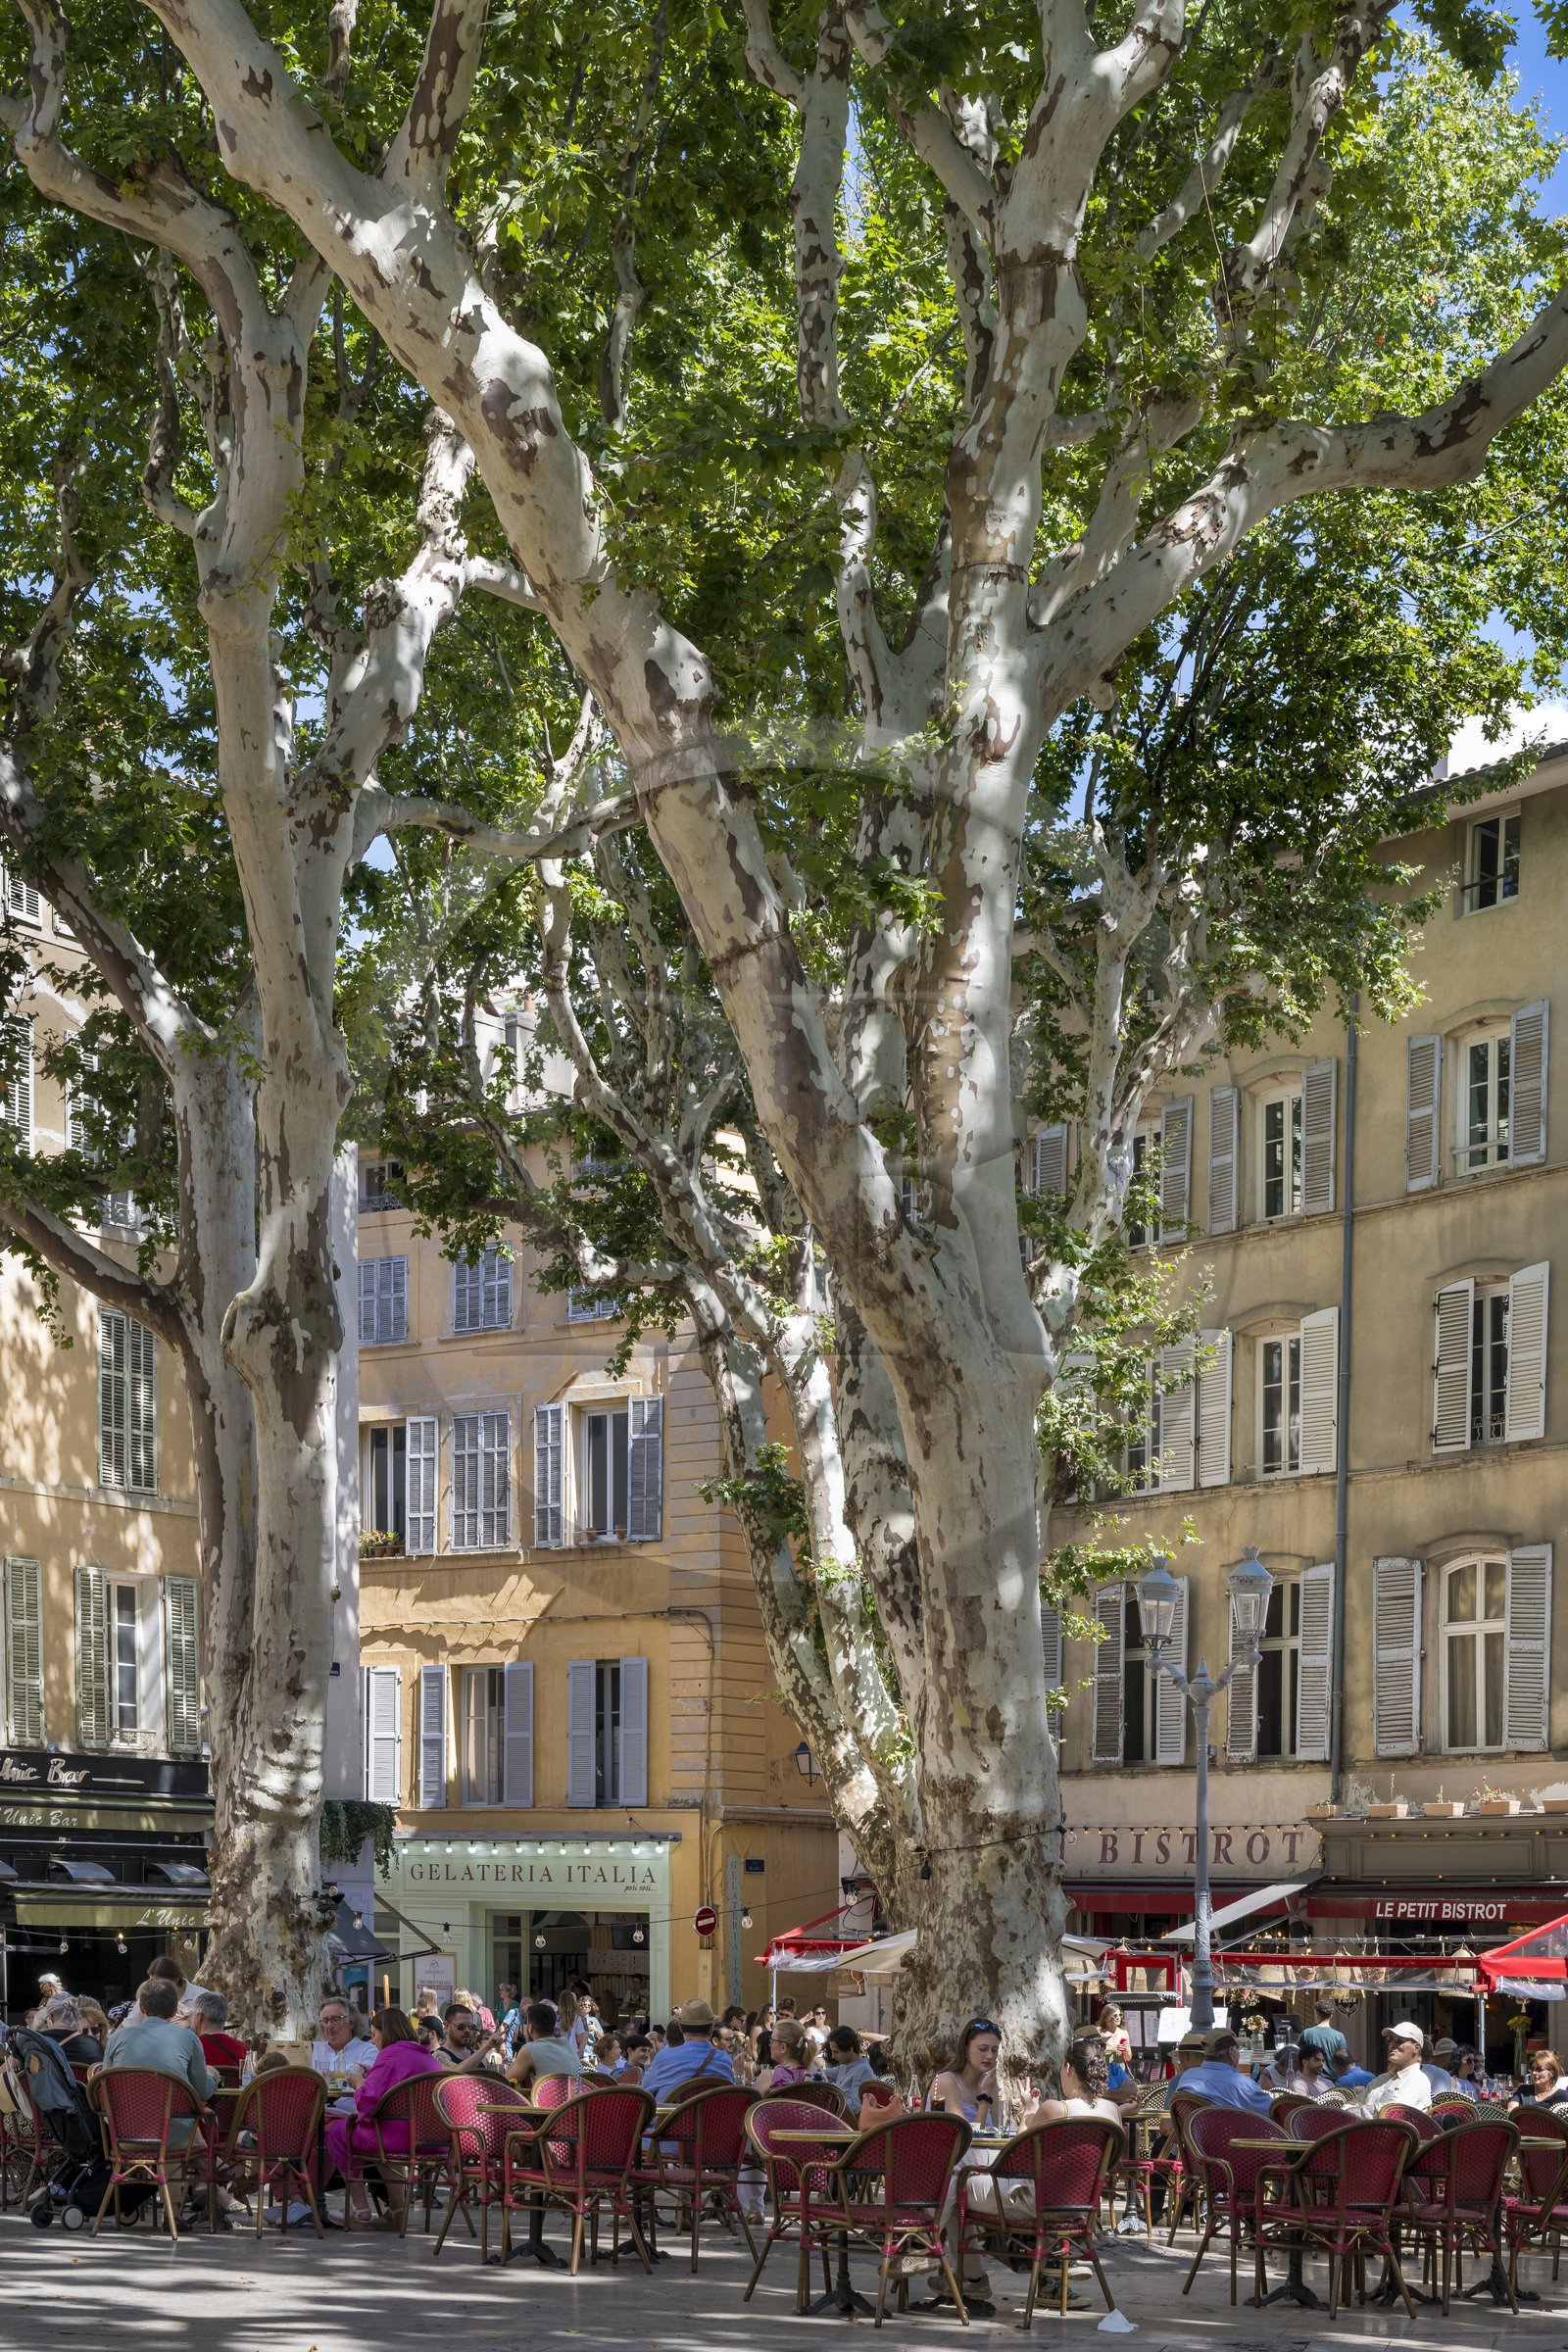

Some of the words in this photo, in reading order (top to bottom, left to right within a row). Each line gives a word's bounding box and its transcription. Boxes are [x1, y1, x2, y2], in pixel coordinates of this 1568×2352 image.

[47, 1758, 90, 1785] Bar
[50, 1810, 78, 1827] Bar
[1098, 1832, 1304, 1865] BISTROT
[410, 1863, 555, 1883] GELATERIA
[566, 1865, 657, 1884] ITALIA
[136, 1908, 196, 1926] L'Unic
[1376, 1902, 1395, 1918] LE
[1397, 1902, 1439, 1919] PETIT
[1442, 1903, 1507, 1920] BISTROT
